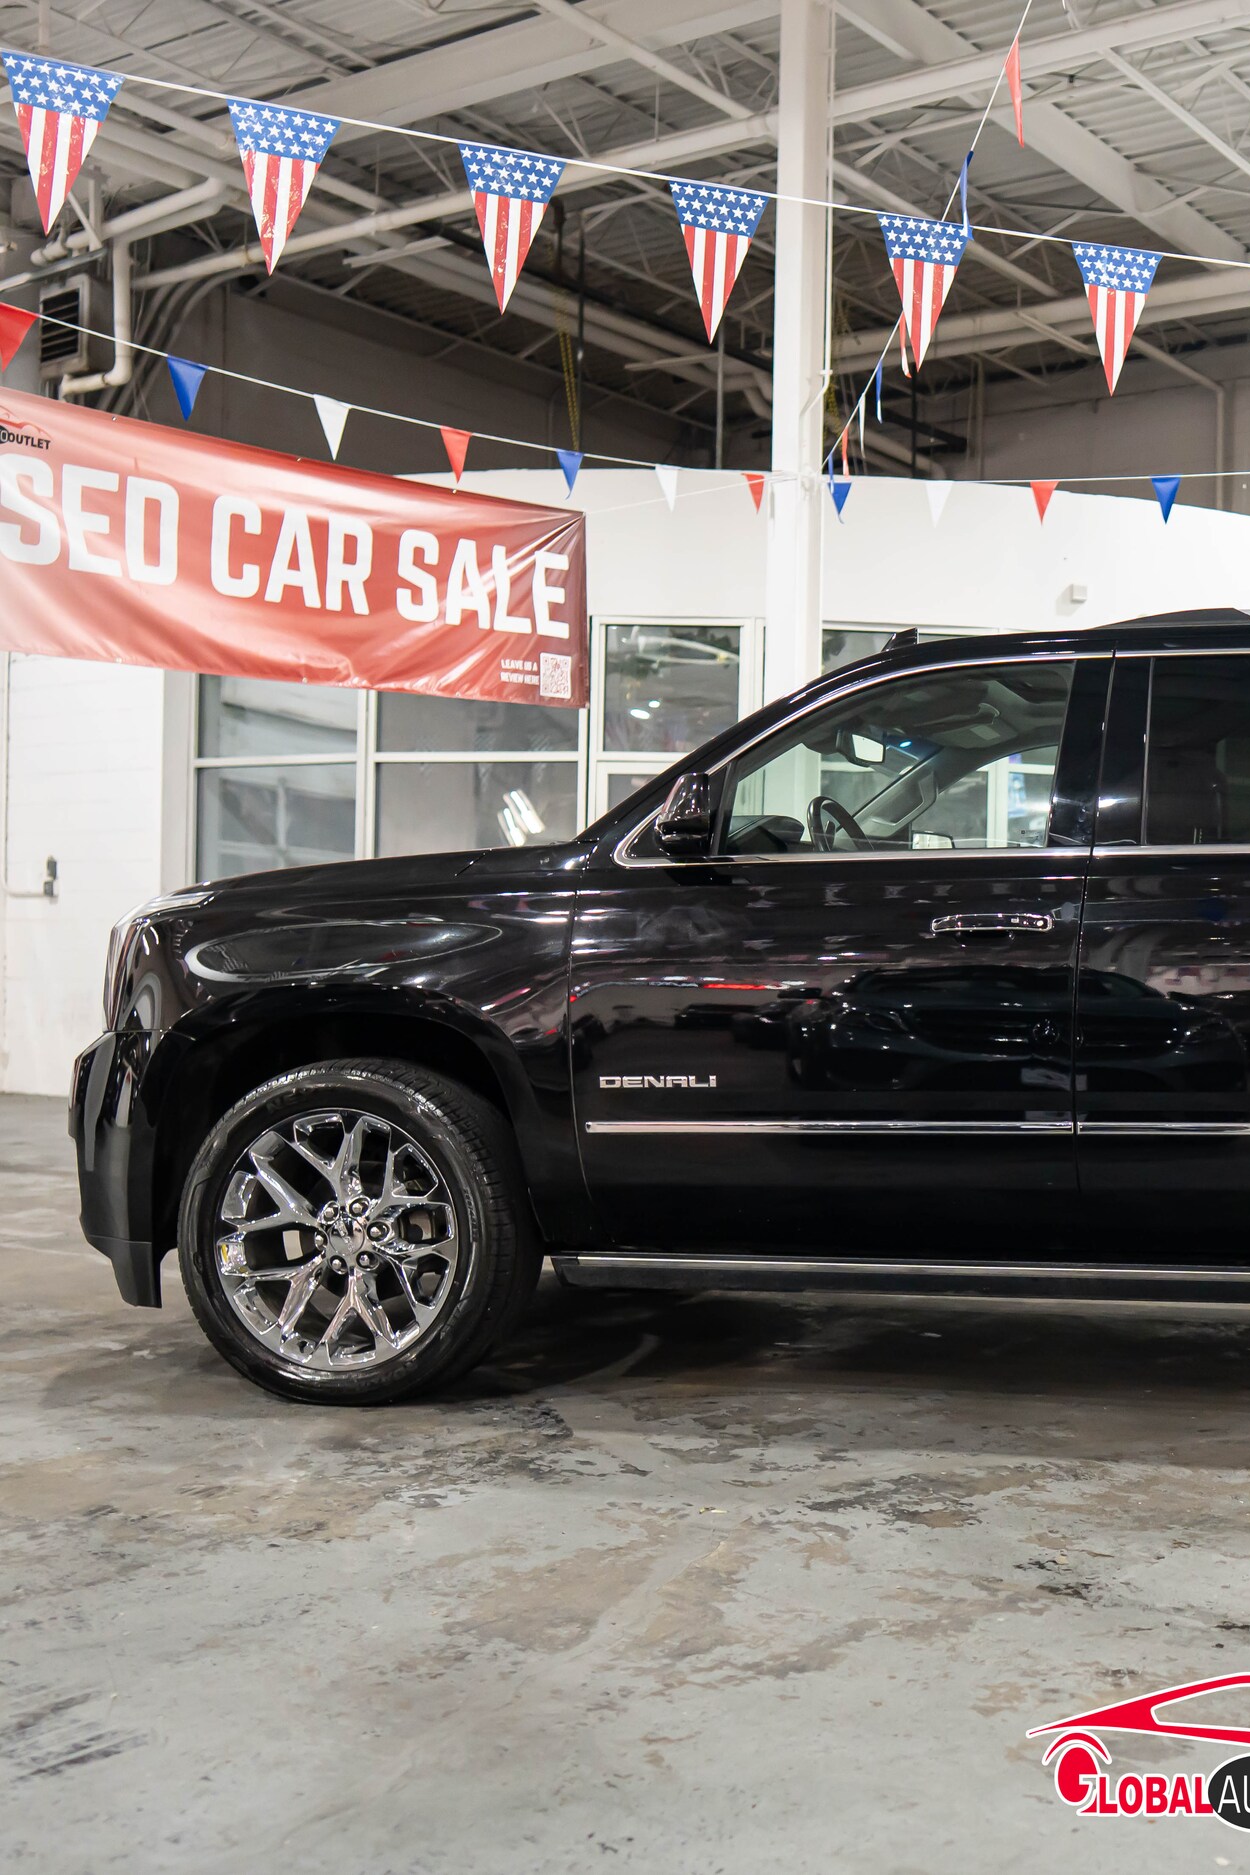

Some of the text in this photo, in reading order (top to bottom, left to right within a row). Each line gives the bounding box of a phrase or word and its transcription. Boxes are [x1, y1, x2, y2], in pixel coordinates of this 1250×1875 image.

[210, 494, 373, 616] CAR
[396, 529, 569, 640] SALE
[599, 1075, 717, 1088] DENALI
